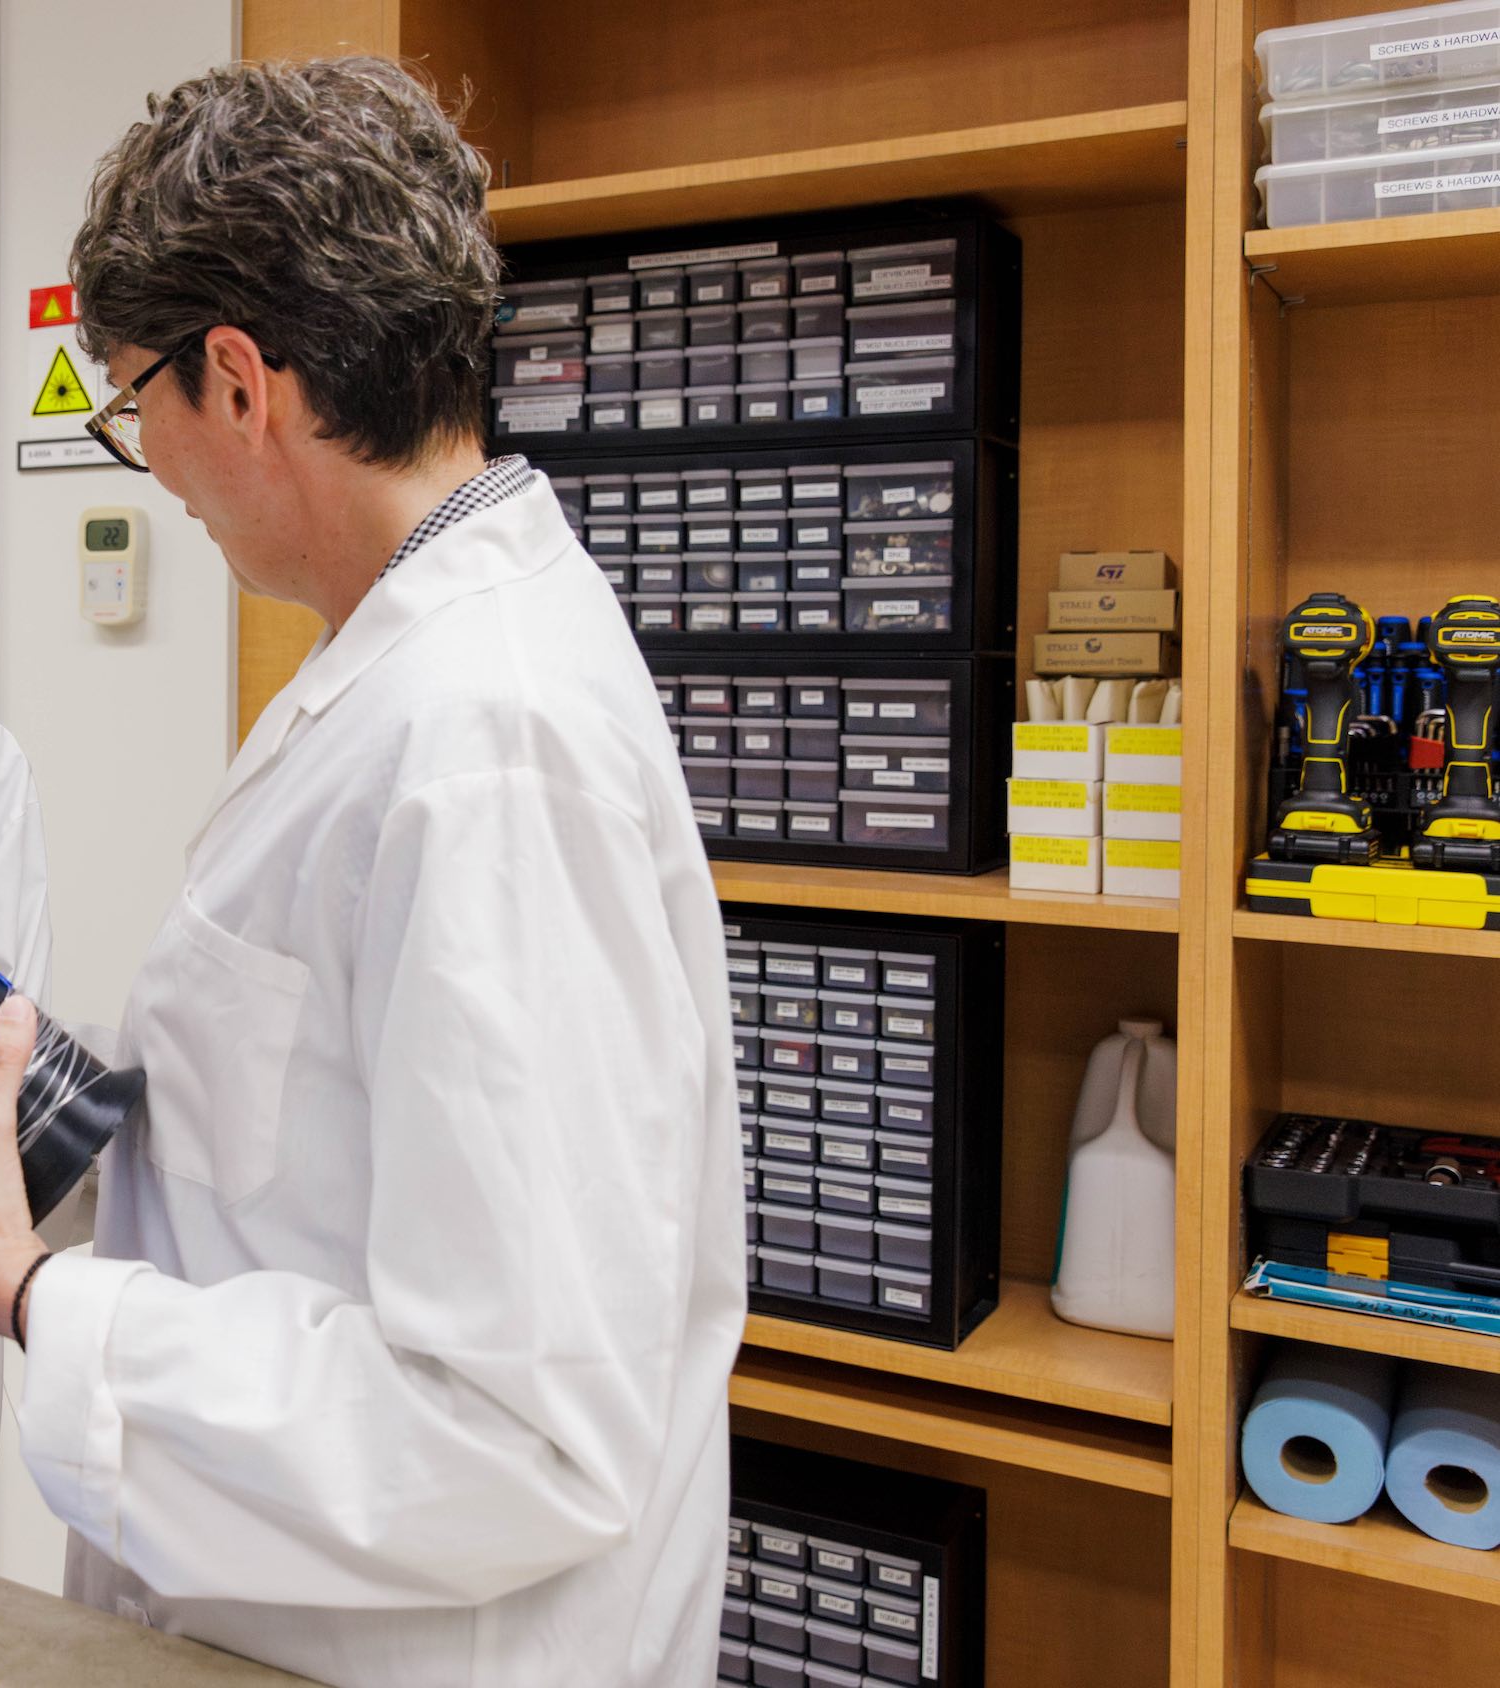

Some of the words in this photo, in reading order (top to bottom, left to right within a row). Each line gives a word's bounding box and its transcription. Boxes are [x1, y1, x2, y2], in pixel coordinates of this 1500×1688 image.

[1378, 41, 1429, 56] SCREWS
[1433, 38, 1441, 48] &
[1387, 115, 1439, 129] SCREWS
[1442, 112, 1450, 122] &
[1381, 180, 1433, 194] SCREWS
[1435, 178, 1444, 188] &
[1303, 626, 1344, 634] ATOMIC
[1452, 631, 1496, 639] ATOMIC
